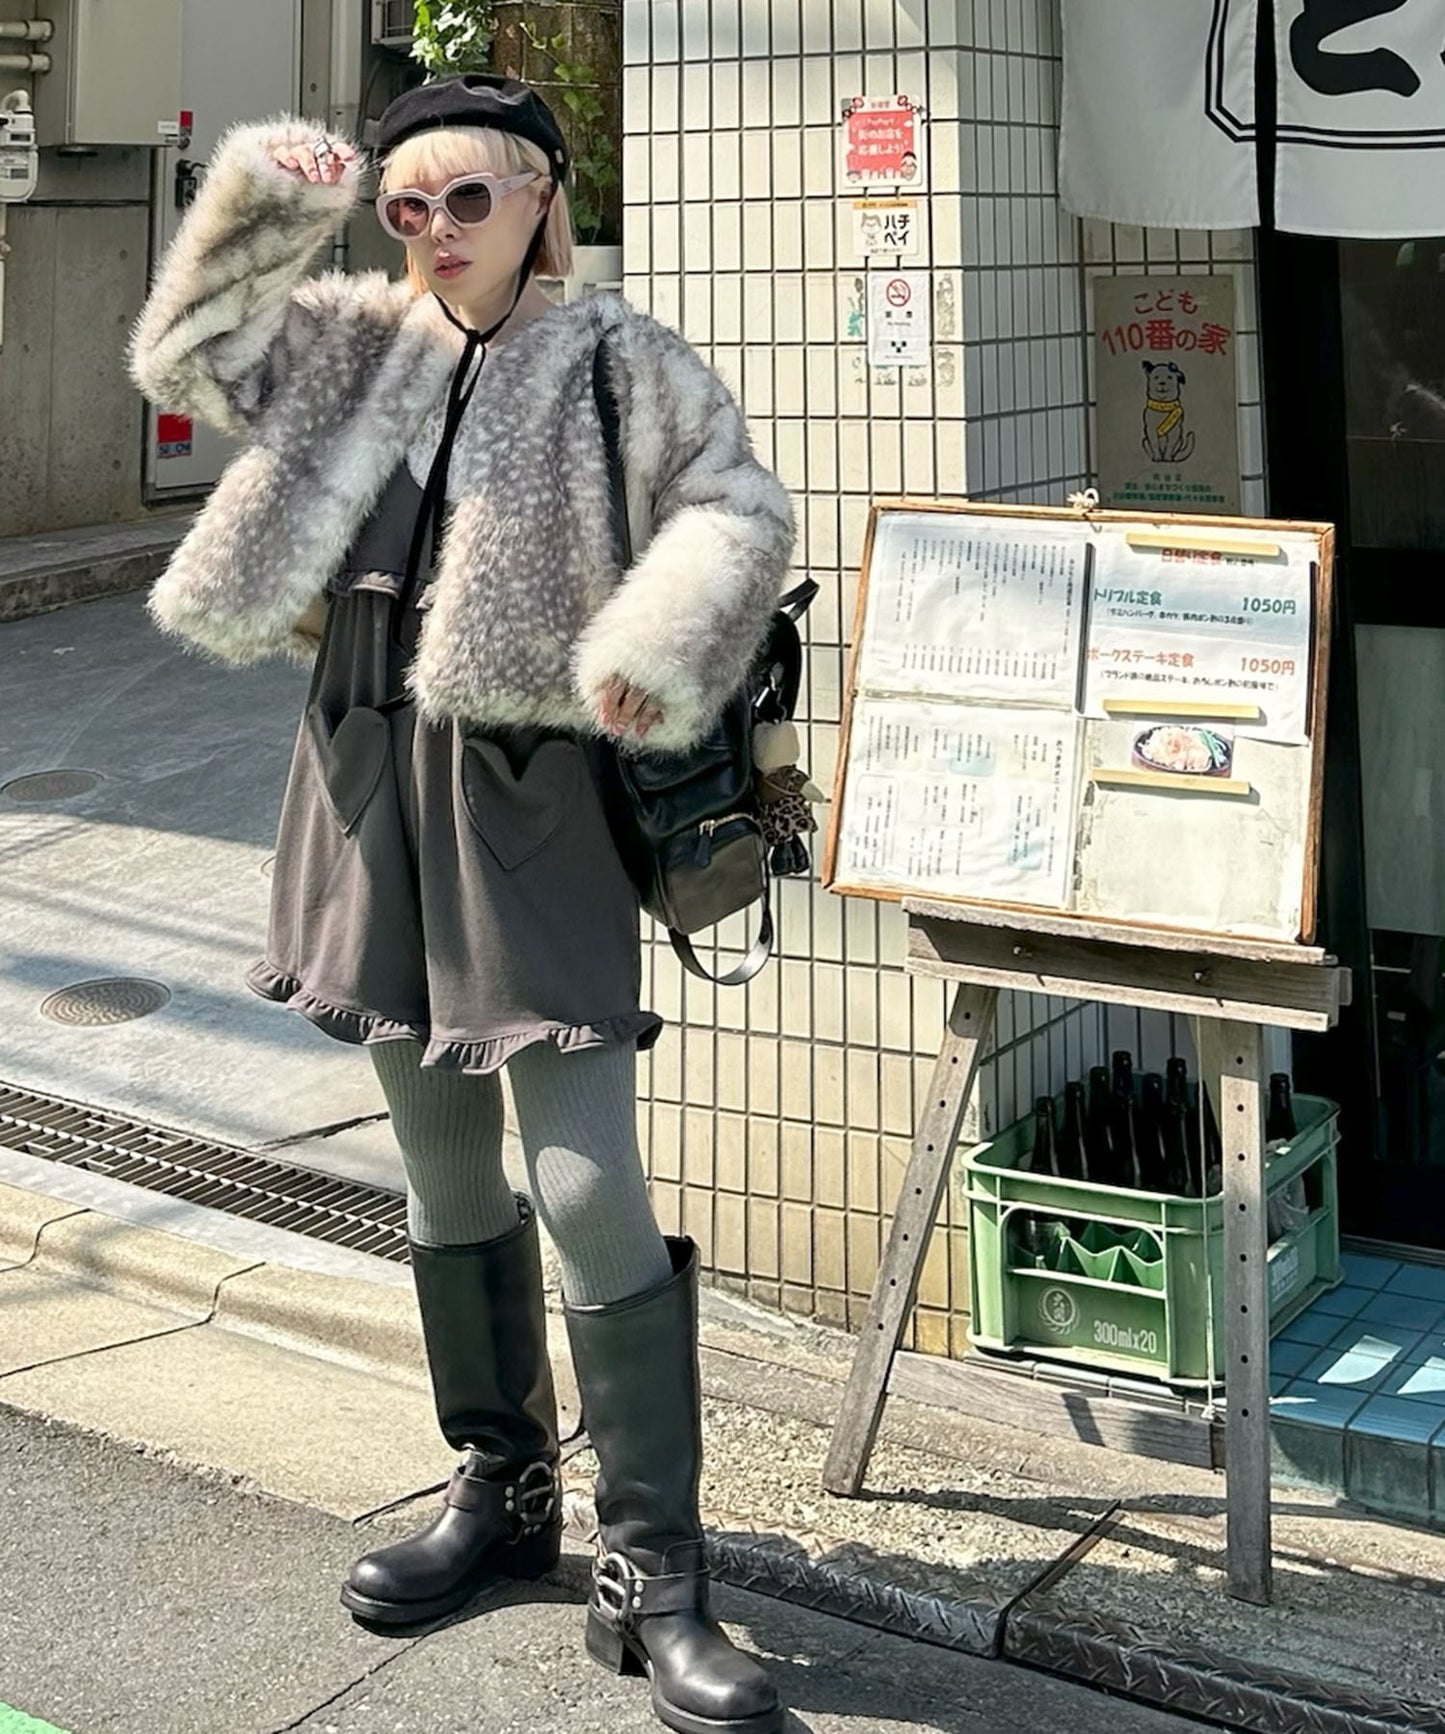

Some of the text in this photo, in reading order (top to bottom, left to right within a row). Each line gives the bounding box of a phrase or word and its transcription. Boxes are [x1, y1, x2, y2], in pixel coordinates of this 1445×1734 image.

[885, 214, 911, 229] ハチ
[885, 230, 911, 246] ペイ
[1134, 289, 1199, 315] こども
[1102, 319, 1231, 356] 110番の家
[1243, 597, 1296, 615] 1050円
[1241, 657, 1295, 676] 1050円
